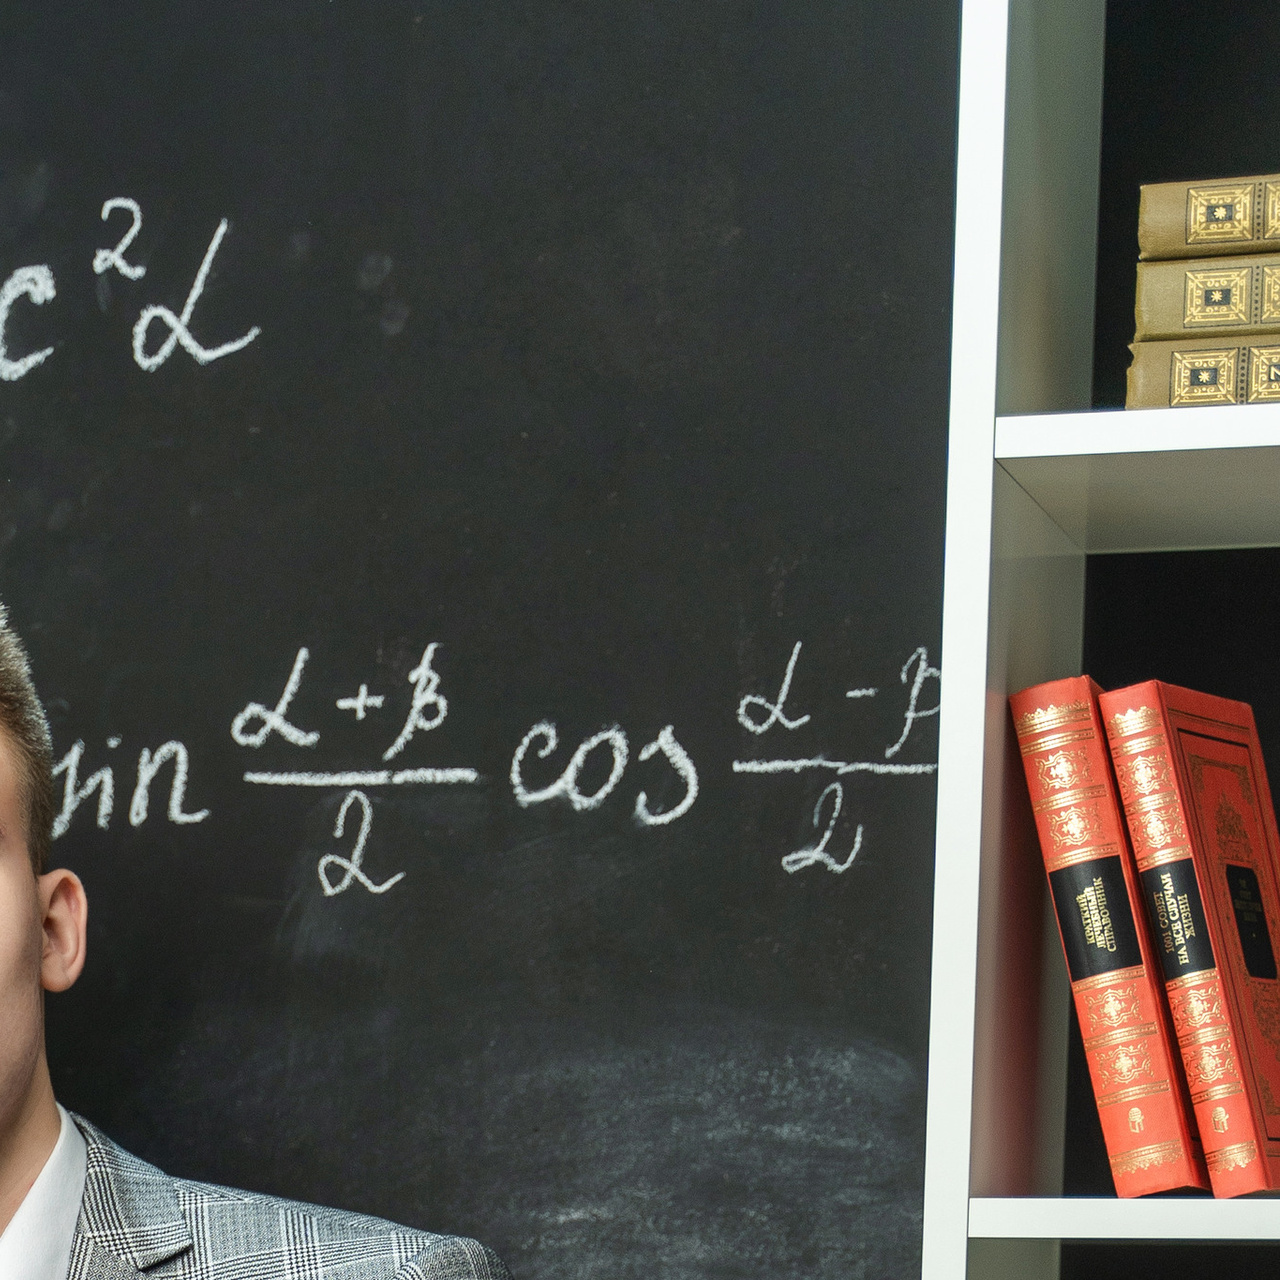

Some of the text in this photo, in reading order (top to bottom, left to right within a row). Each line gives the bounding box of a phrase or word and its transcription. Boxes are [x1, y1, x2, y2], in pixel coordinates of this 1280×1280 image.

[1077, 893, 1095, 945] КРАТКИЙ
[1084, 885, 1106, 949] ЛЕЧЕБНЫЙ
[1093, 877, 1117, 953] СПРАВОЧНИК
[1154, 892, 1175, 954] 1001 СОВЕТ
[1174, 926, 1185, 949] ВСЕ
[1177, 893, 1196, 938] ЖИЗНИ
[1177, 950, 1190, 965] НА
